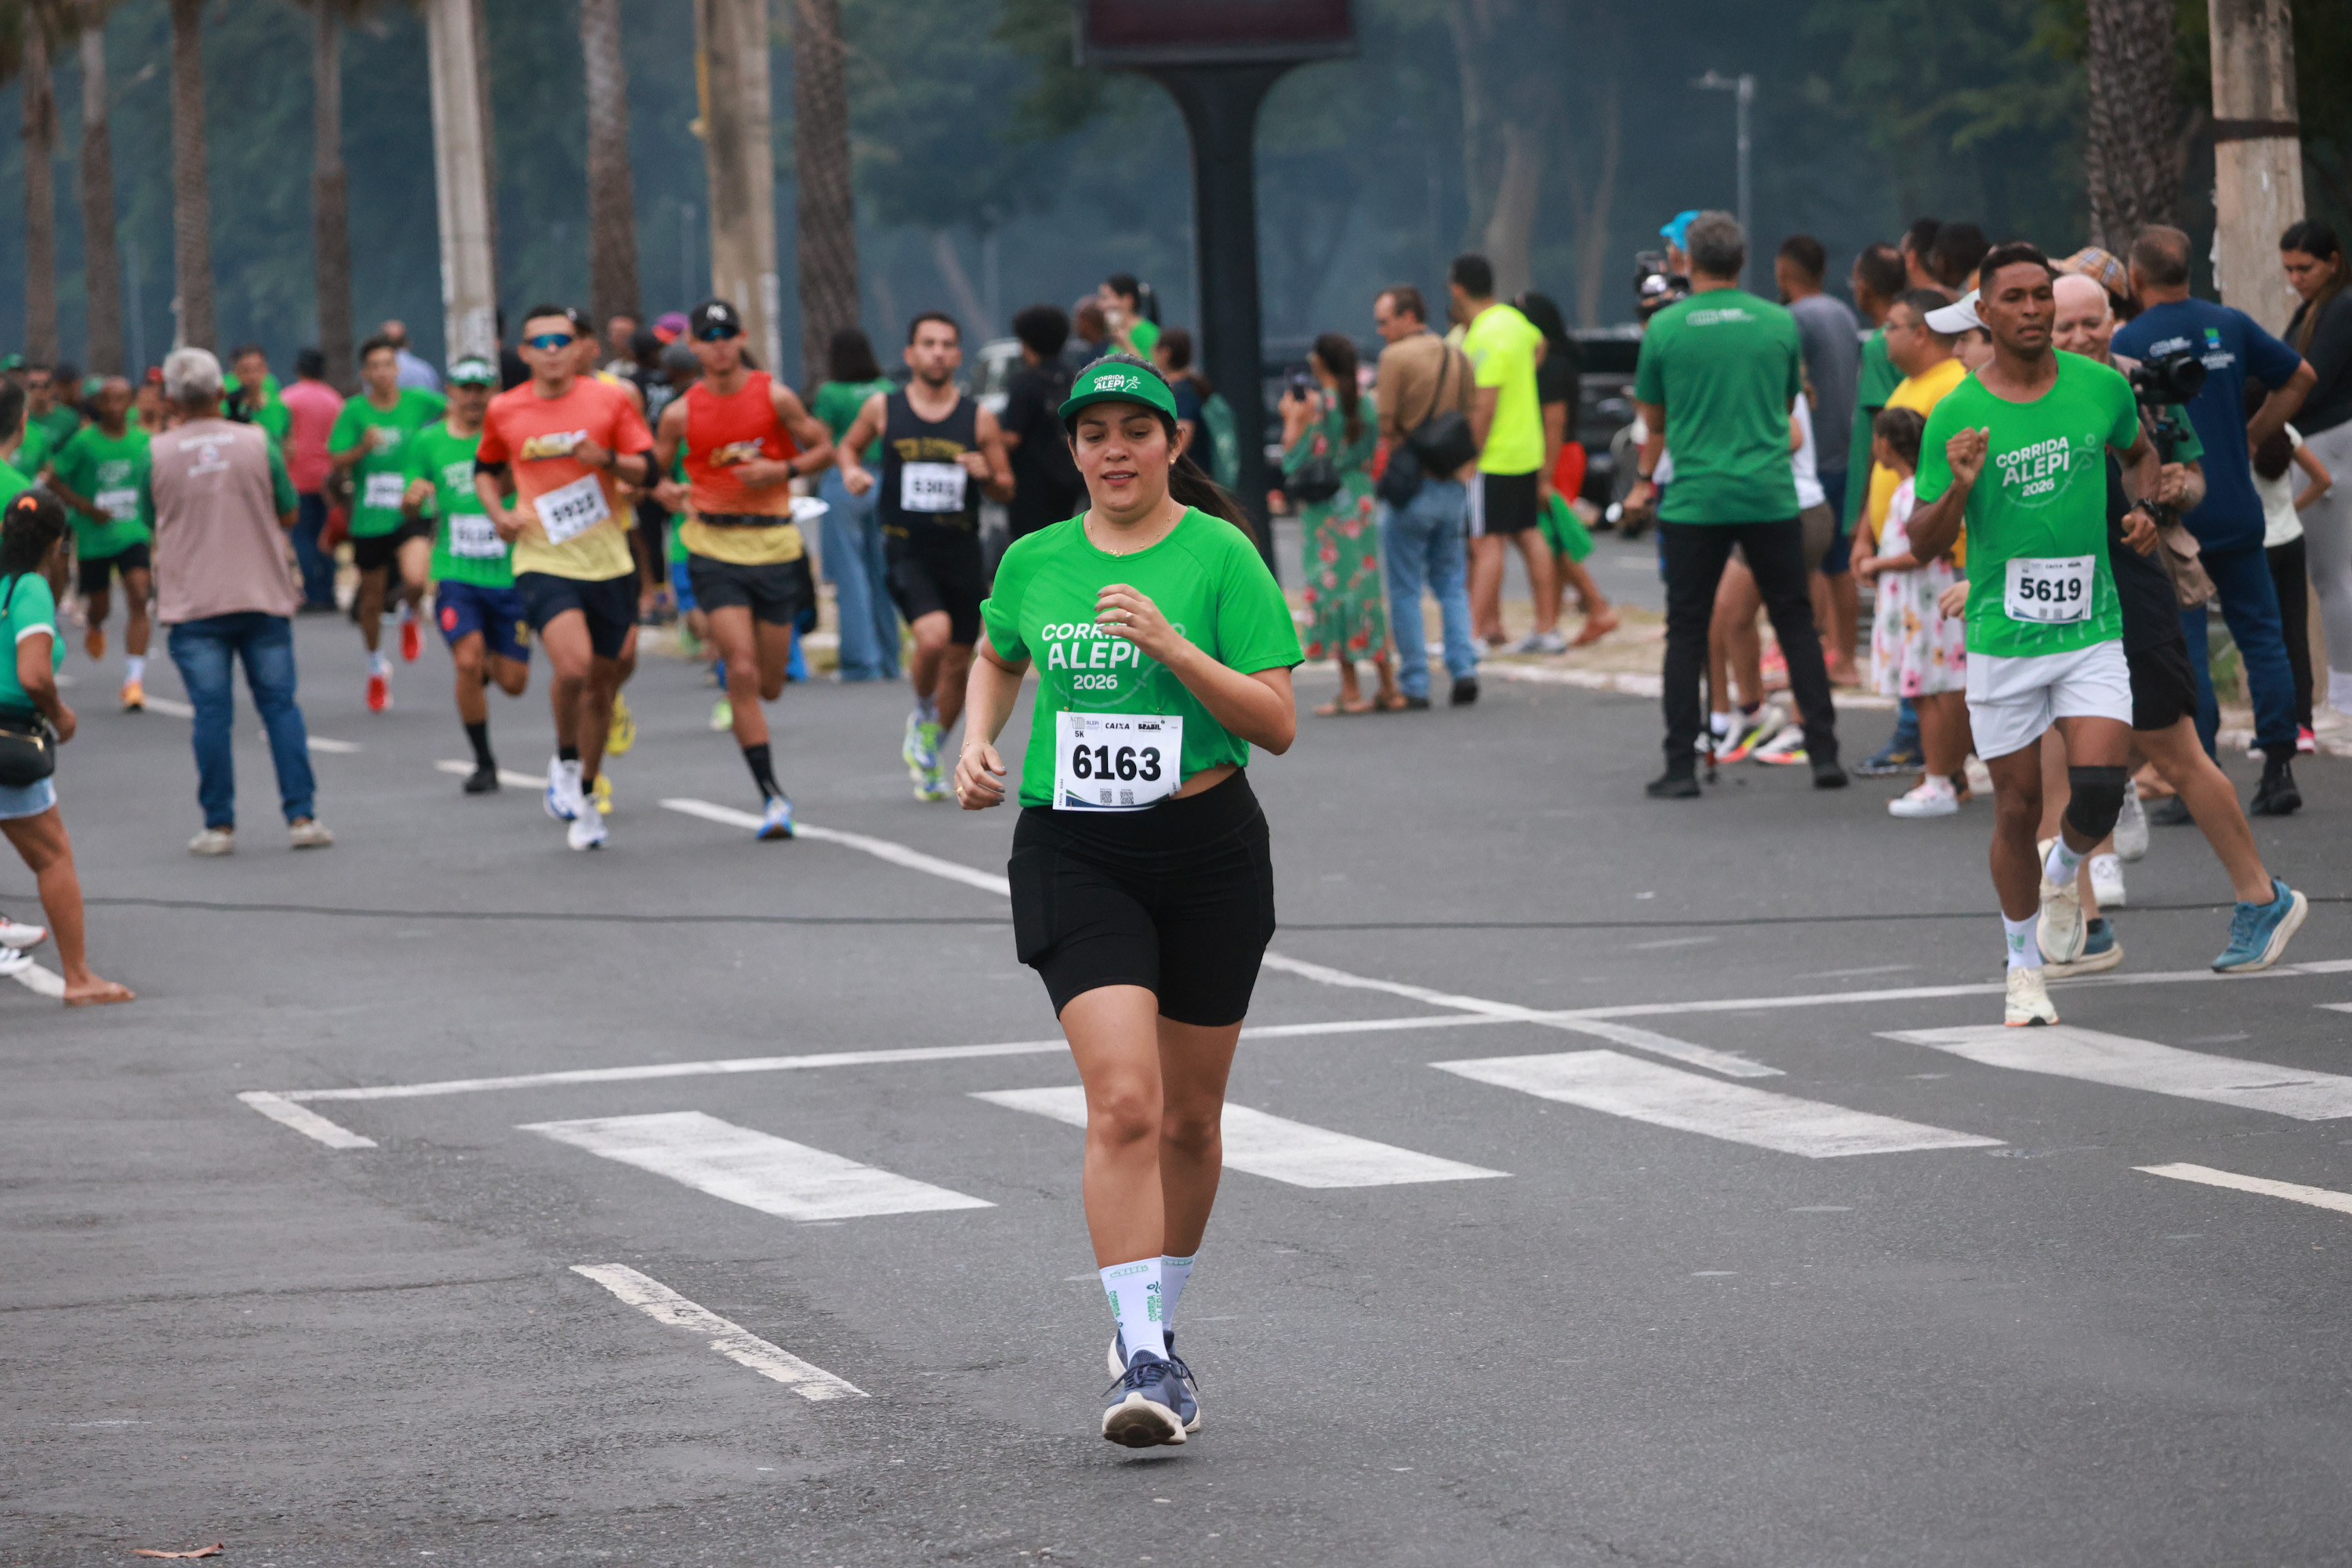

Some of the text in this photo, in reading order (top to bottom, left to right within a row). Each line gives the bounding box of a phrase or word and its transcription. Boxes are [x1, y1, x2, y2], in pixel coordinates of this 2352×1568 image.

[1094, 375, 1124, 383] CORRIDA
[1094, 379, 1124, 391] ALEPI
[1996, 436, 2069, 468] CORRIDA
[2002, 450, 2070, 488] ALEPI
[2022, 477, 2055, 497] 2026
[2020, 577, 2082, 602] 5619
[1041, 622, 1127, 641] CORR
[1048, 641, 1141, 670] ALEPI
[1073, 674, 1118, 690] 2026
[1073, 744, 1161, 782] 6163
[1109, 1290, 1120, 1317] CORRIDA
[1147, 1295, 1157, 1322] CORRIDA
